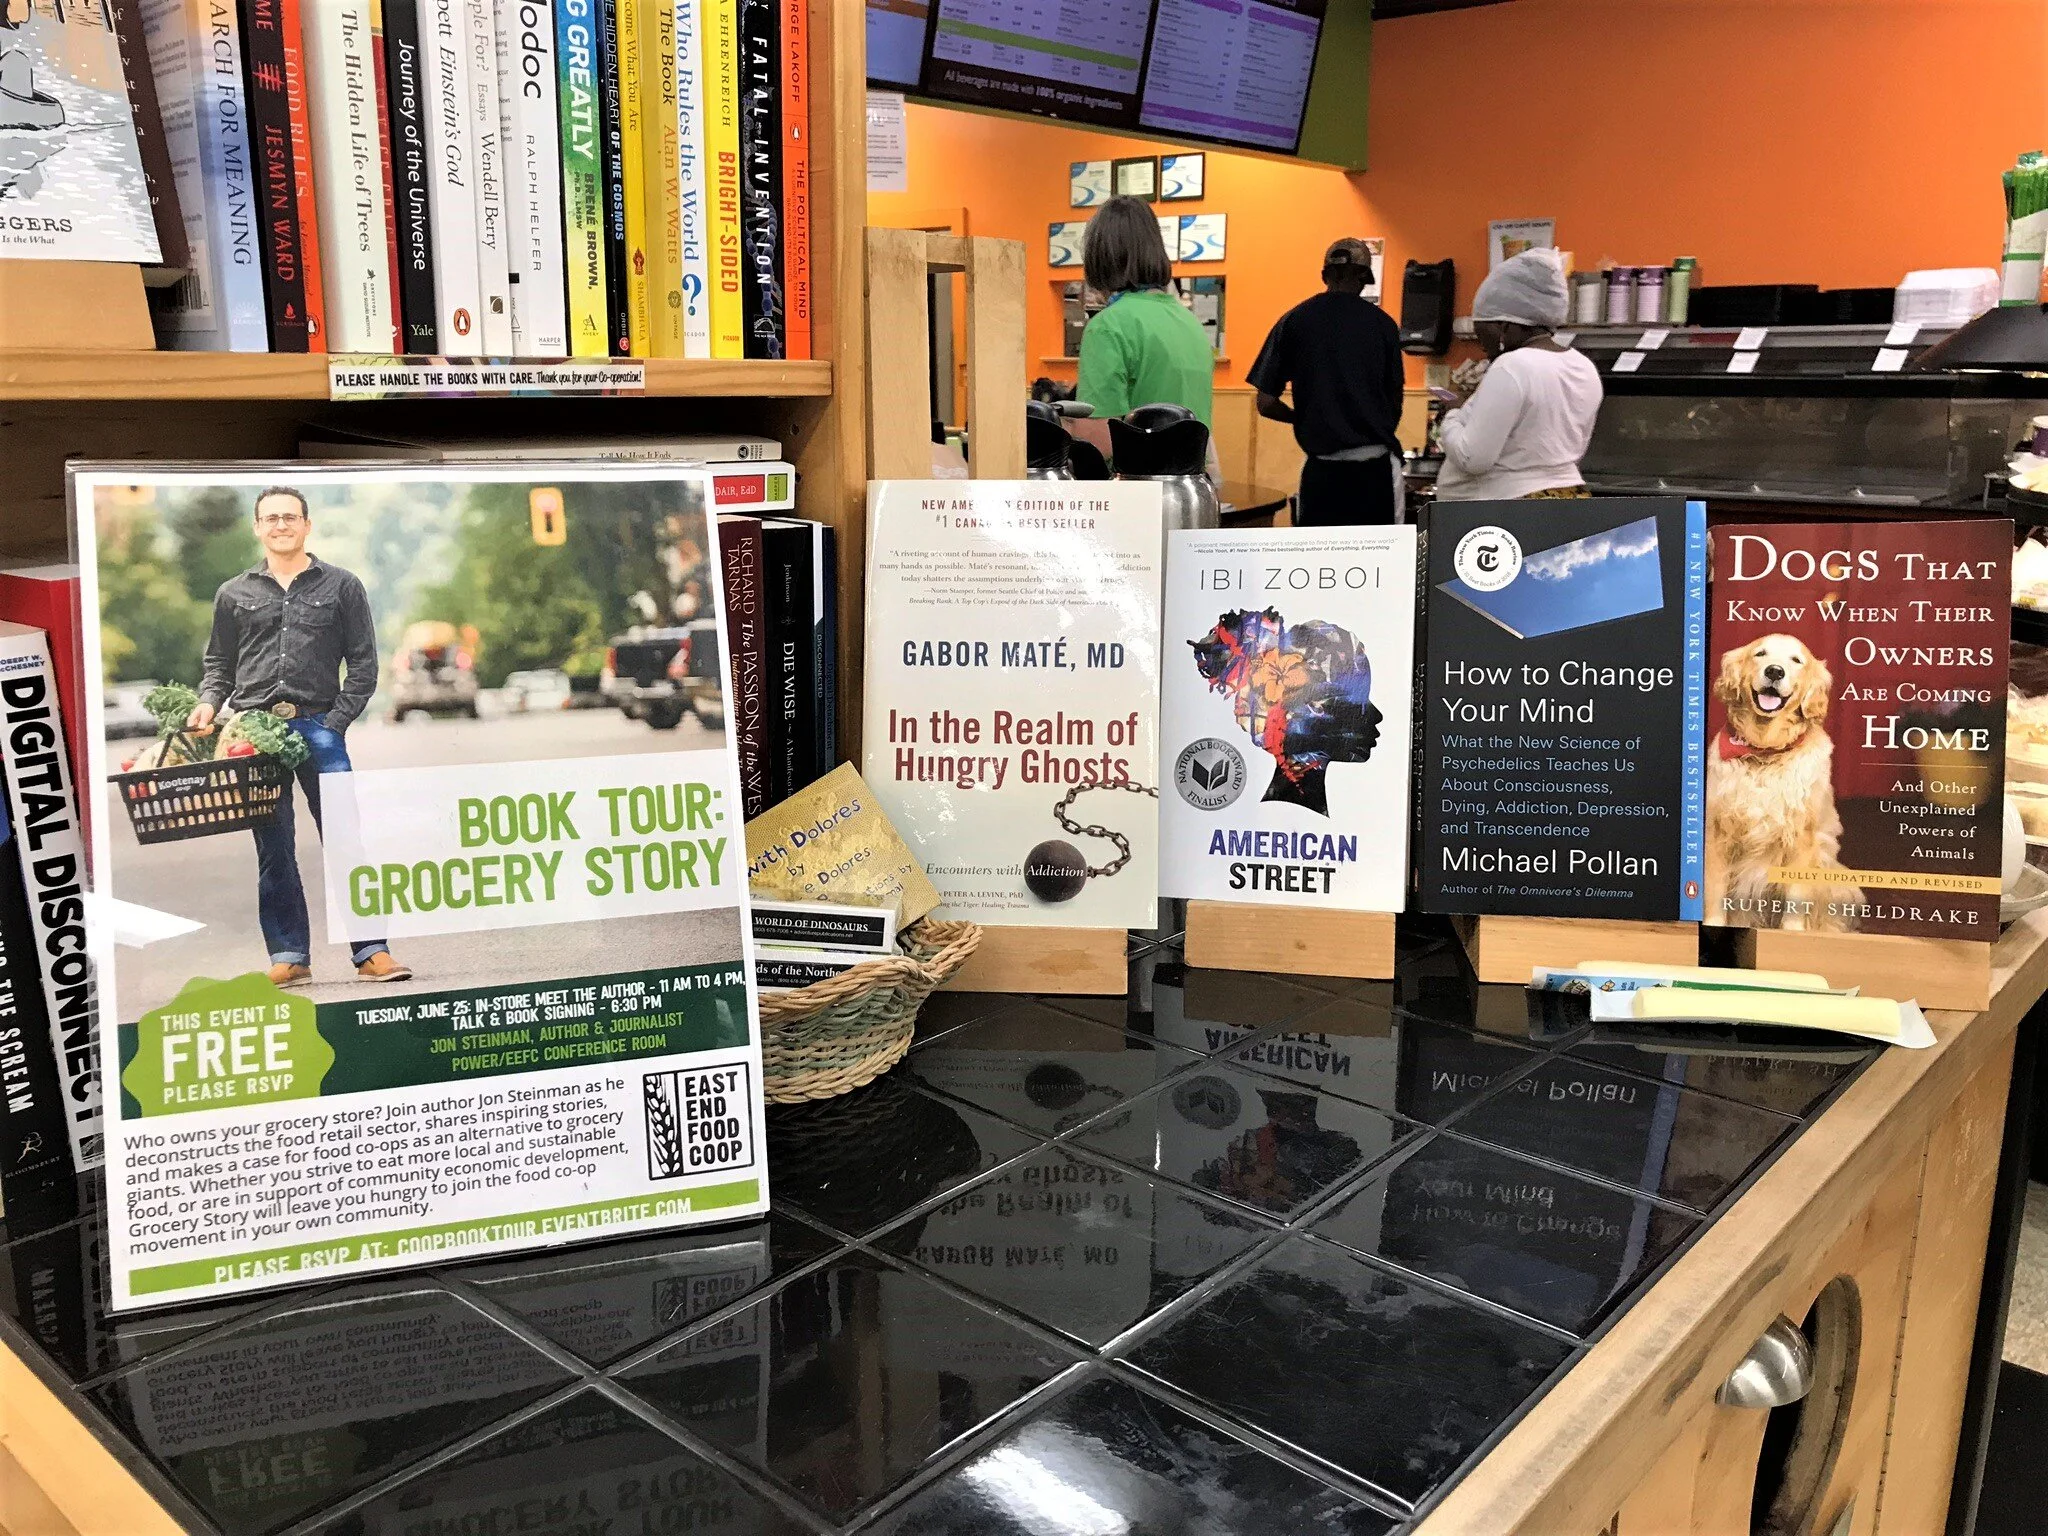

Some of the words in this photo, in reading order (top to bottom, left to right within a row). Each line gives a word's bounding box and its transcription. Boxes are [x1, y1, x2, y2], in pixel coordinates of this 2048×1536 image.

[341, 11, 359, 48] The
[660, 9, 673, 46] The
[675, 1, 692, 60] Who
[344, 53, 364, 126] Hidden
[398, 39, 416, 121] Journey
[567, 26, 594, 160] GREATLY
[662, 54, 676, 105] Book
[752, 37, 768, 117] FATAL
[789, 41, 800, 103] LAKOFF
[217, 84, 239, 134] FOR
[439, 47, 461, 140] Einstein's
[678, 68, 694, 136] Rules
[351, 132, 369, 170] Life
[404, 125, 423, 147] of
[265, 125, 288, 209] JESMYN
[406, 151, 424, 182] the
[446, 146, 464, 188] God
[481, 132, 499, 203] Wendell
[526, 134, 538, 194] RALPH
[680, 143, 696, 182] the
[223, 143, 251, 265] MEANING
[355, 174, 371, 195] of
[584, 172, 598, 225] BRENÉ
[356, 198, 372, 252] Trees
[409, 187, 426, 271] Universe
[481, 207, 499, 250] Berry
[682, 190, 699, 260] World
[718, 151, 738, 293] BRIGHT-SIDED
[754, 139, 771, 284] INVENTION
[272, 219, 294, 282] WARD
[530, 201, 542, 271] HELFER
[586, 231, 598, 290] BROWN,
[410, 324, 434, 336] Yale
[336, 373, 376, 387] PLEASE
[380, 373, 420, 386] HANDLE
[423, 373, 443, 385] THE
[448, 372, 478, 385] BOOKS
[481, 372, 506, 385] WITH
[509, 372, 535, 384] CARE.
[537, 371, 558, 383] Thank
[558, 373, 571, 384] you
[571, 371, 583, 383] for
[583, 373, 599, 384] your
[598, 370, 642, 384] Co-operation!
[740, 485, 756, 495] EdD
[728, 545, 742, 612] TARNAS
[740, 537, 755, 615] RICHARD
[900, 562, 923, 570] hands
[1200, 568, 1243, 590] IBI
[1264, 567, 1380, 589] ZOBOI
[1689, 558, 1702, 600] NEW
[1894, 553, 1997, 582] THAT
[1726, 600, 1806, 623] KNOW
[1815, 600, 1899, 623] WHEN
[1908, 600, 1995, 623] THEIR
[902, 640, 989, 667] GABOR
[1001, 636, 1076, 672] MATÉ,
[1087, 642, 1125, 669] MD
[1687, 607, 1701, 662] YORK
[1843, 636, 1995, 667] OWNERS
[783, 642, 795, 673] DIE
[1444, 661, 1512, 686] How
[1521, 662, 1550, 686] to
[1559, 661, 1674, 691] Change
[743, 651, 760, 731] PASSION
[784, 676, 795, 720] WISE
[1442, 697, 1510, 723] Your
[1520, 698, 1595, 724] Mind
[1687, 672, 1699, 732] TIMES
[1839, 683, 1889, 702] ARE
[1896, 683, 1992, 704] COMING
[889, 709, 918, 744] In
[929, 710, 981, 744] the
[993, 710, 1094, 745] Realm
[1107, 711, 1139, 746] of
[1861, 714, 1990, 752] HOME
[0, 675, 70, 851] DIGITAL
[157, 774, 207, 790] Kootenay
[895, 748, 1009, 790] Hungry
[1021, 748, 1130, 785] Ghosts
[1442, 756, 1540, 772] Psychedelics
[1547, 757, 1609, 772] Teaches
[1614, 759, 1635, 772] Us
[459, 790, 581, 848] BOOK
[598, 781, 725, 837] TOUR:
[1187, 790, 1228, 806] FINALIST
[1686, 740, 1699, 865] BESTSELLER
[790, 799, 861, 848] Dolores
[817, 846, 871, 885] Dolores
[1208, 829, 1358, 862] AMERICAN
[1441, 846, 1556, 874] Michael
[1569, 849, 1658, 876] Pollan
[348, 848, 563, 919] GROCERY
[586, 836, 729, 896] STORY
[925, 862, 993, 876] Encounters
[996, 861, 1022, 876] with
[1026, 864, 1085, 877] Addiction
[1228, 862, 1336, 894] STREET
[1780, 870, 1819, 881] FULLY
[1824, 873, 1885, 884] UPDATED
[1890, 876, 1919, 885] AND
[1924, 878, 1983, 890] REVISED
[1520, 886, 1581, 897] Omnivore's
[1585, 888, 1634, 898] Dilemma
[1722, 897, 1815, 916] RUPERT
[1827, 901, 1979, 925] SHELDRAKE
[754, 917, 793, 928] WORLD
[795, 919, 809, 929] OF
[811, 920, 869, 932] DINOSAURS
[160, 1012, 201, 1032] THIS
[209, 1006, 266, 1027] EVENT
[274, 1003, 290, 1020] IS
[356, 1006, 413, 1026] TUESDAY,
[418, 1002, 449, 1019] JUNE
[453, 1000, 472, 1015] 25:
[475, 994, 531, 1014] IN-STORE
[534, 989, 569, 1009] MEET
[572, 987, 597, 1005] THE
[600, 981, 645, 1002] AUTHOR
[672, 977, 691, 993] AM
[725, 970, 746, 986] PM,
[451, 1014, 486, 1032] TALK
[505, 1007, 539, 1025] BOOK
[545, 1002, 595, 1022] SIGNING
[611, 996, 637, 1014] 6:30
[642, 994, 663, 1010] PM
[162, 1023, 293, 1083] FREE
[430, 1035, 457, 1055] JON
[461, 1029, 534, 1052] STEINMAN,
[539, 1023, 588, 1042] AUTHOR
[609, 1011, 684, 1034] JOURNALIST
[452, 1049, 539, 1072] POWER/EEFC
[543, 1040, 627, 1062] CONFERENCE
[631, 1034, 666, 1052] ROOM
[0, 1028, 34, 1114] SCREAM
[163, 1080, 237, 1105] PLEASE
[247, 1073, 294, 1094] RSVP
[685, 1070, 739, 1098] EAST
[124, 1131, 165, 1152] Who
[170, 1127, 217, 1146] owns
[221, 1122, 262, 1148] your
[265, 1113, 328, 1137] grocery
[332, 1106, 382, 1126] store?
[685, 1095, 727, 1122] END
[687, 1117, 741, 1145] FOOD
[689, 1140, 743, 1167] COOP
[214, 1255, 291, 1285] PLEASE
[299, 1247, 351, 1269] RSVP
[358, 1242, 389, 1262] AT:
[397, 1197, 692, 1257] COOPBOOKTOUR.EVENTBRITE.COM
